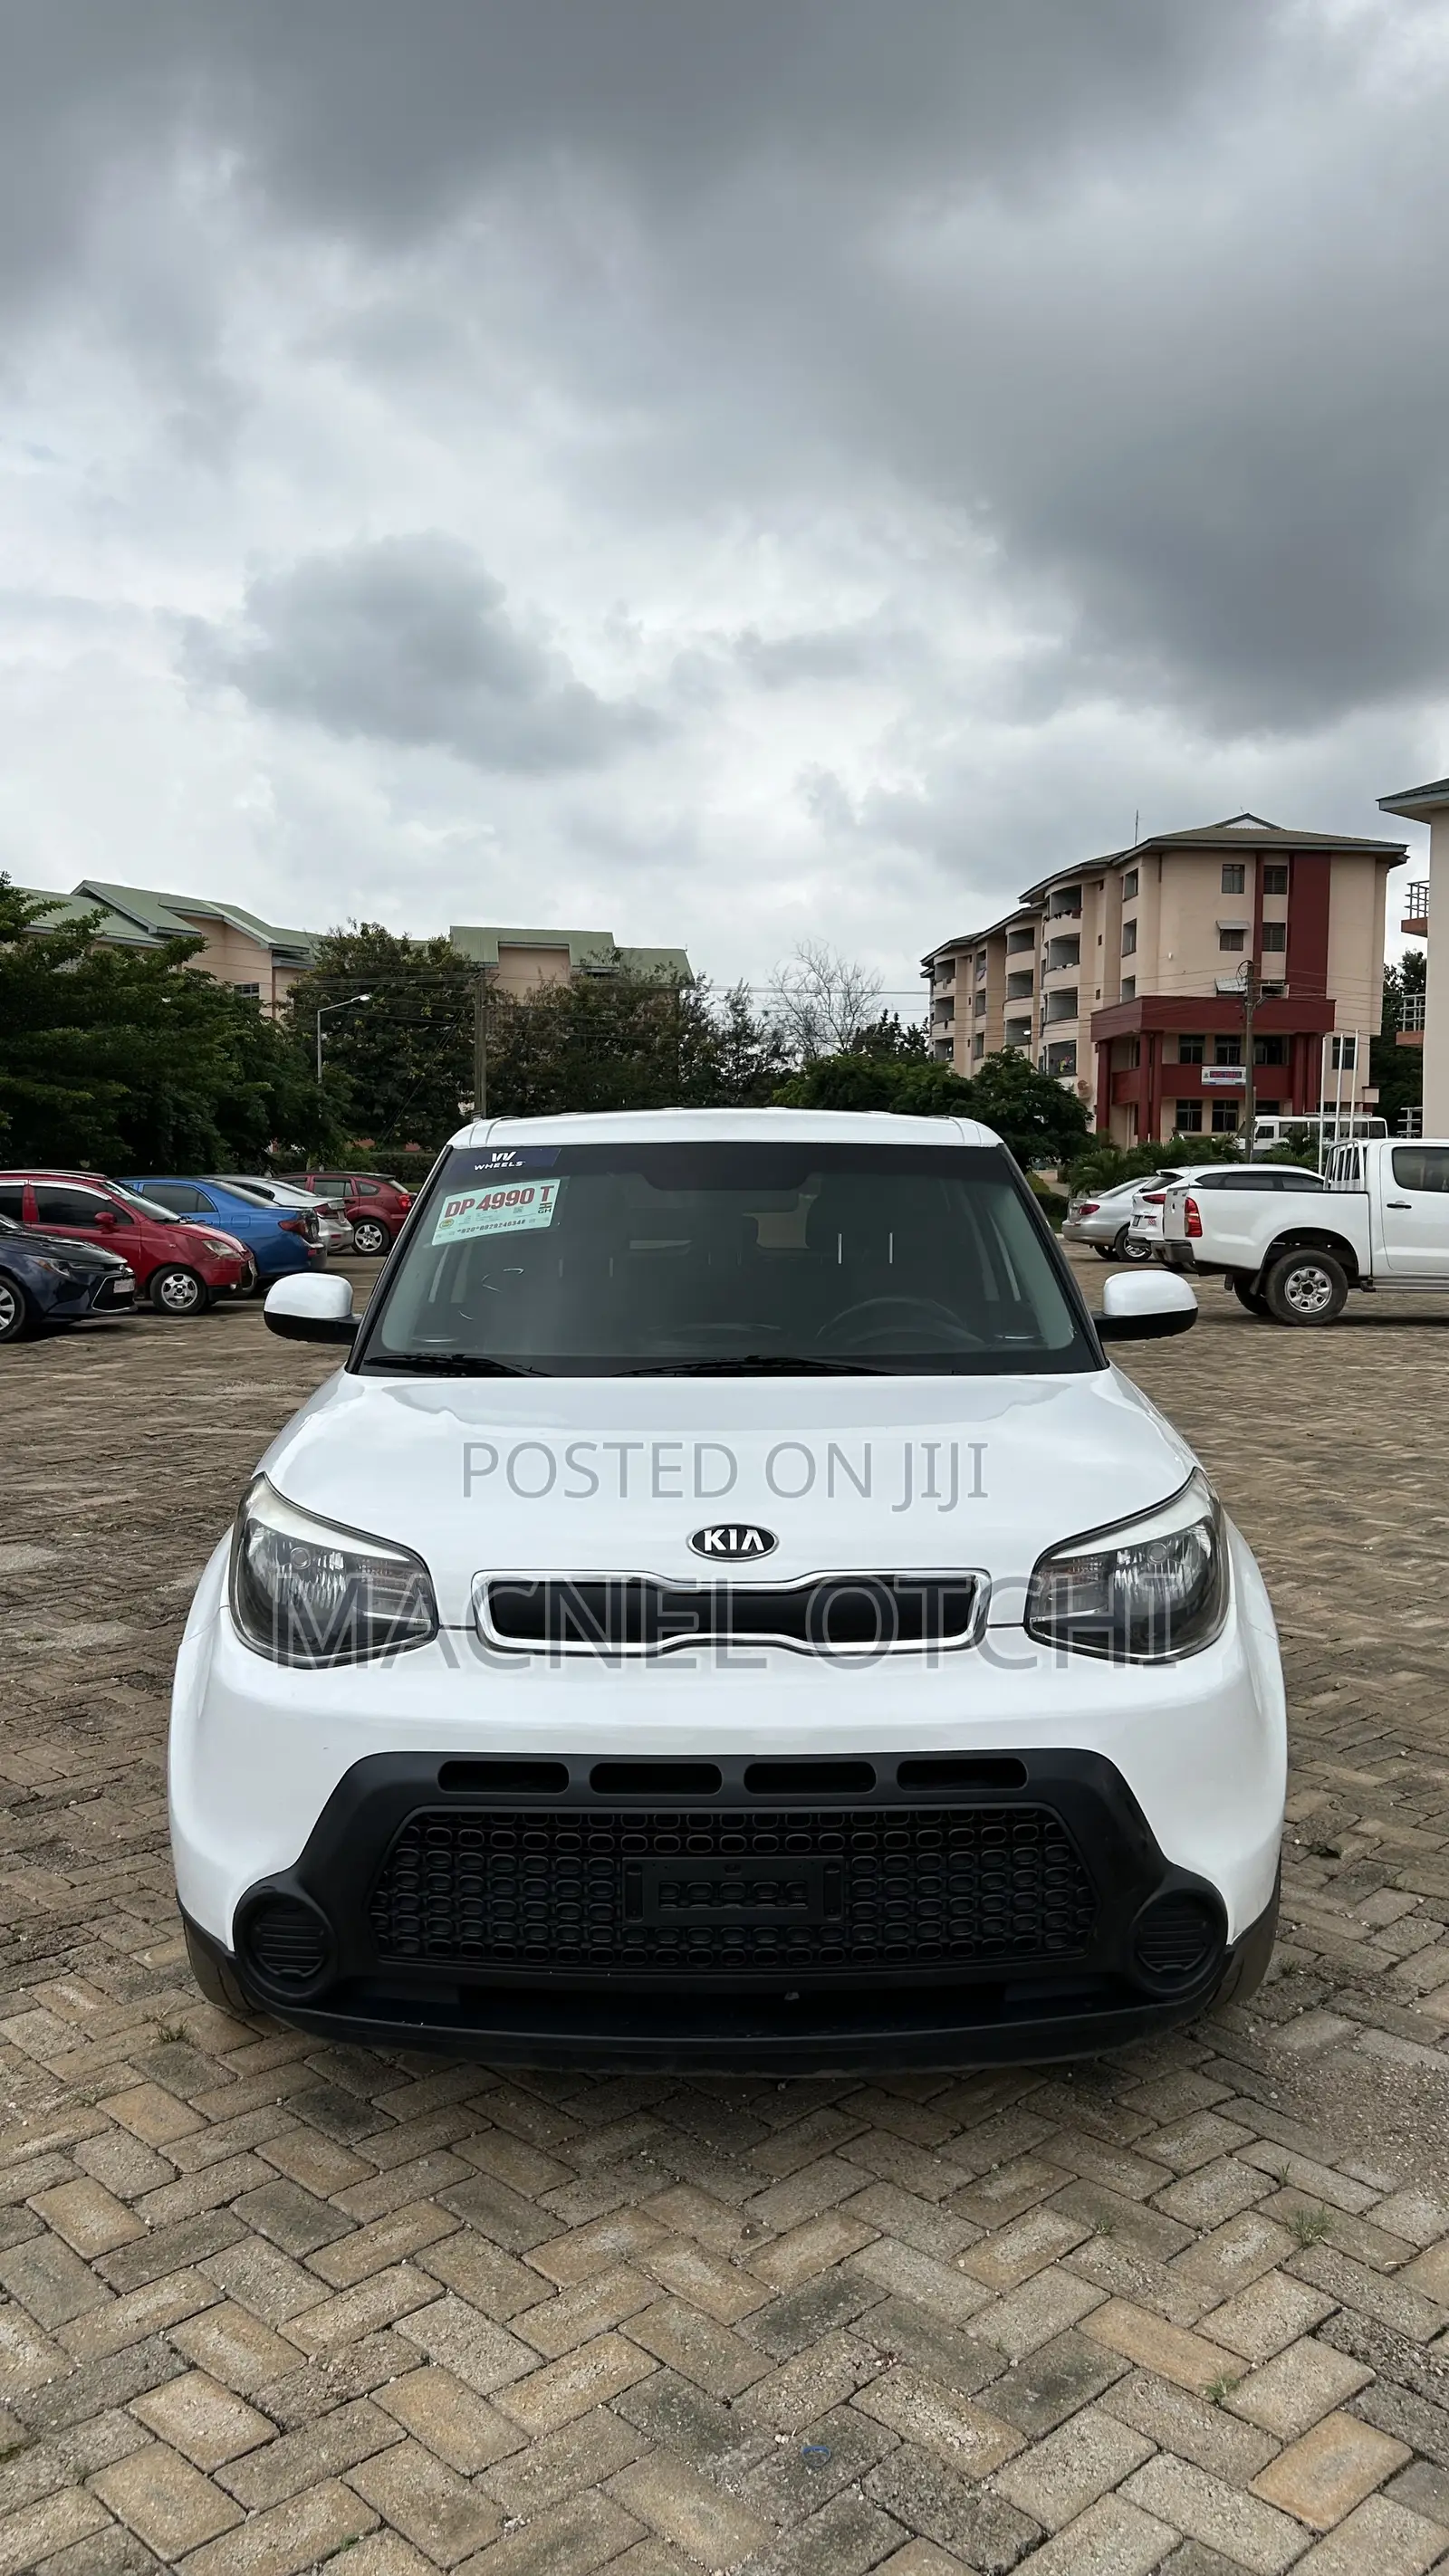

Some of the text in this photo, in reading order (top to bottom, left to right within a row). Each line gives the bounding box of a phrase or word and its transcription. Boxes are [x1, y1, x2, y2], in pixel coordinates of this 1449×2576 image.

[474, 1161, 523, 1171] WHEELS
[445, 1198, 475, 1218] DP
[476, 1188, 535, 1211] 4990
[541, 1185, 554, 1202] T
[704, 1528, 764, 1551] KIA
